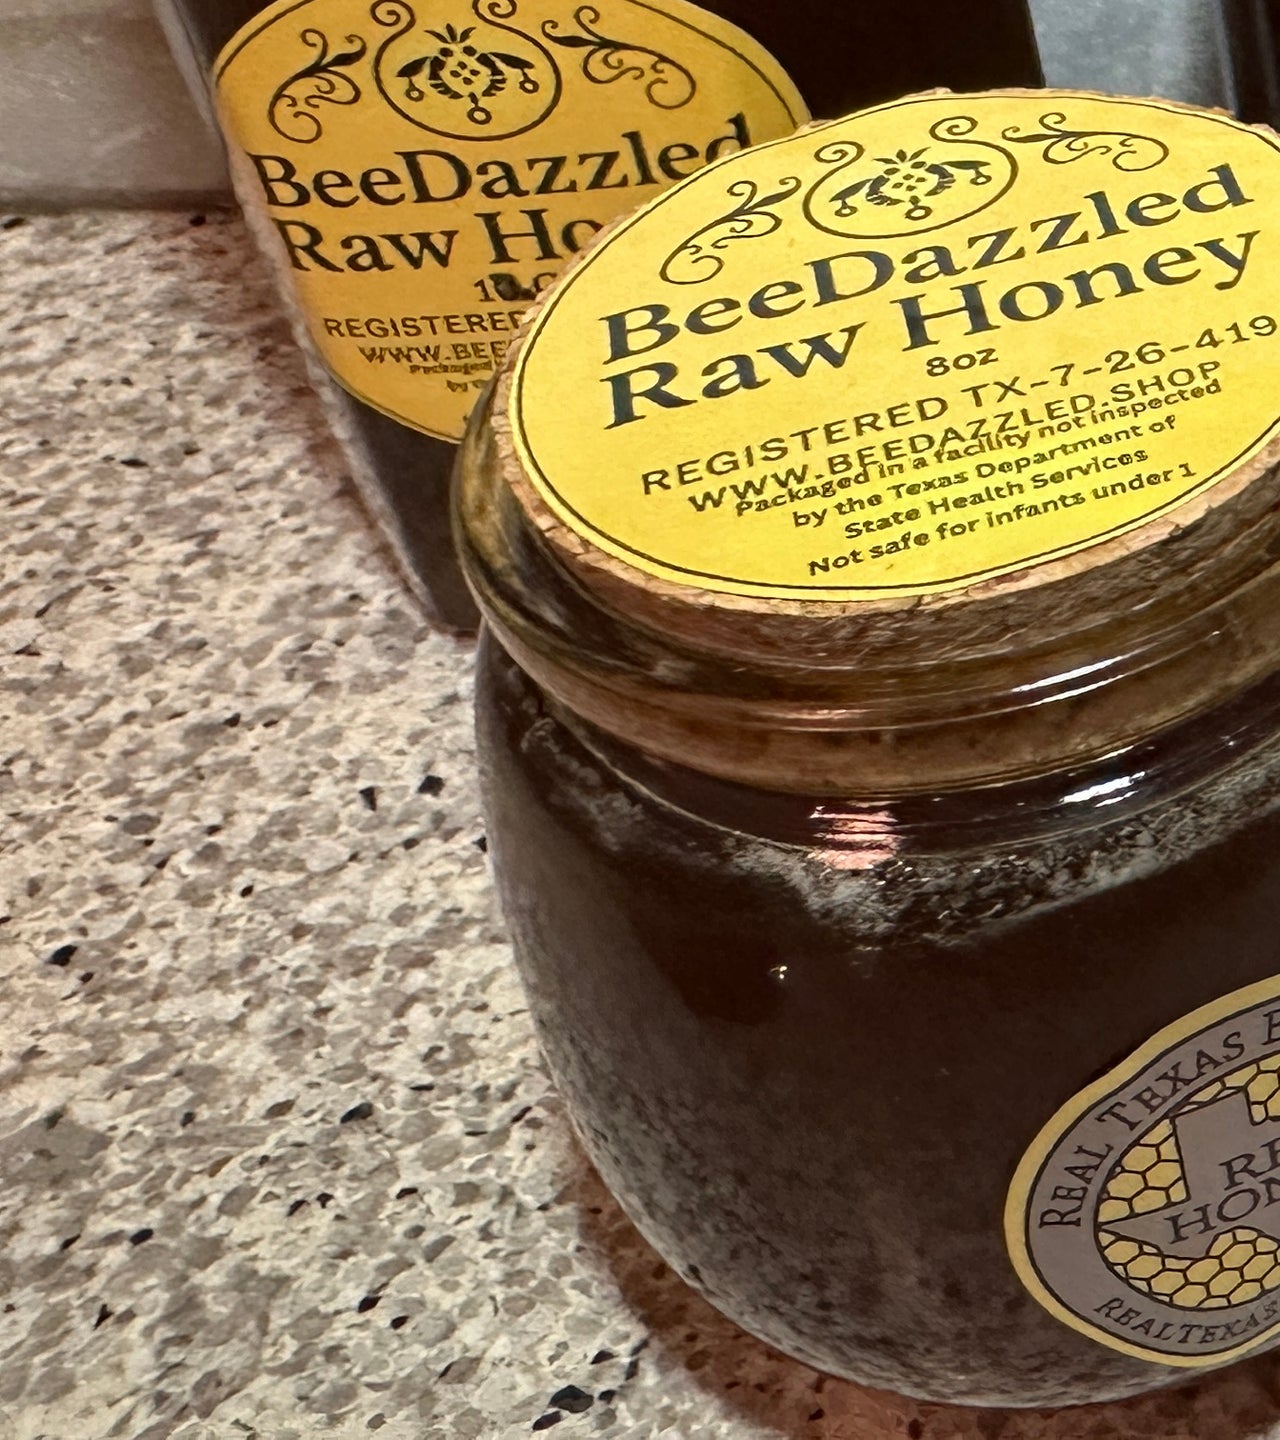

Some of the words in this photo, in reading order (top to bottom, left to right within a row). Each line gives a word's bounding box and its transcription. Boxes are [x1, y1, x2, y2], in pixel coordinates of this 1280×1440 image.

[247, 112, 752, 208] BeeDazzled
[272, 217, 460, 275] Raw
[600, 163, 1254, 362] BeeDazzled
[600, 322, 866, 431] Raw
[899, 230, 1260, 353] Honey
[926, 348, 999, 377] 8oz
[642, 396, 949, 495] REGISTERED
[961, 315, 1278, 408] TX-7-26-419
[688, 360, 1221, 513] WWW.BEEDAZZLED.SHOP
[735, 463, 870, 517] Packaged
[877, 460, 904, 479] in
[912, 455, 928, 470] a
[934, 427, 1031, 464] facility
[1039, 416, 1085, 438] not
[1090, 379, 1222, 427] inspected
[792, 508, 827, 528] by
[834, 494, 883, 516] the
[887, 471, 969, 505] Texas
[976, 424, 1142, 479] Department
[1149, 414, 1176, 434] of
[808, 549, 863, 576] Not
[869, 532, 930, 560] safe
[938, 517, 979, 537] for
[987, 492, 1085, 528] infants
[1091, 468, 1174, 501] under
[1178, 462, 1196, 478] 1
[845, 508, 921, 539] State
[928, 481, 1025, 514] Health
[1033, 449, 1148, 490] Services
[1038, 1143, 1114, 1229] REAL
[1095, 1031, 1246, 1131] TEXAS
